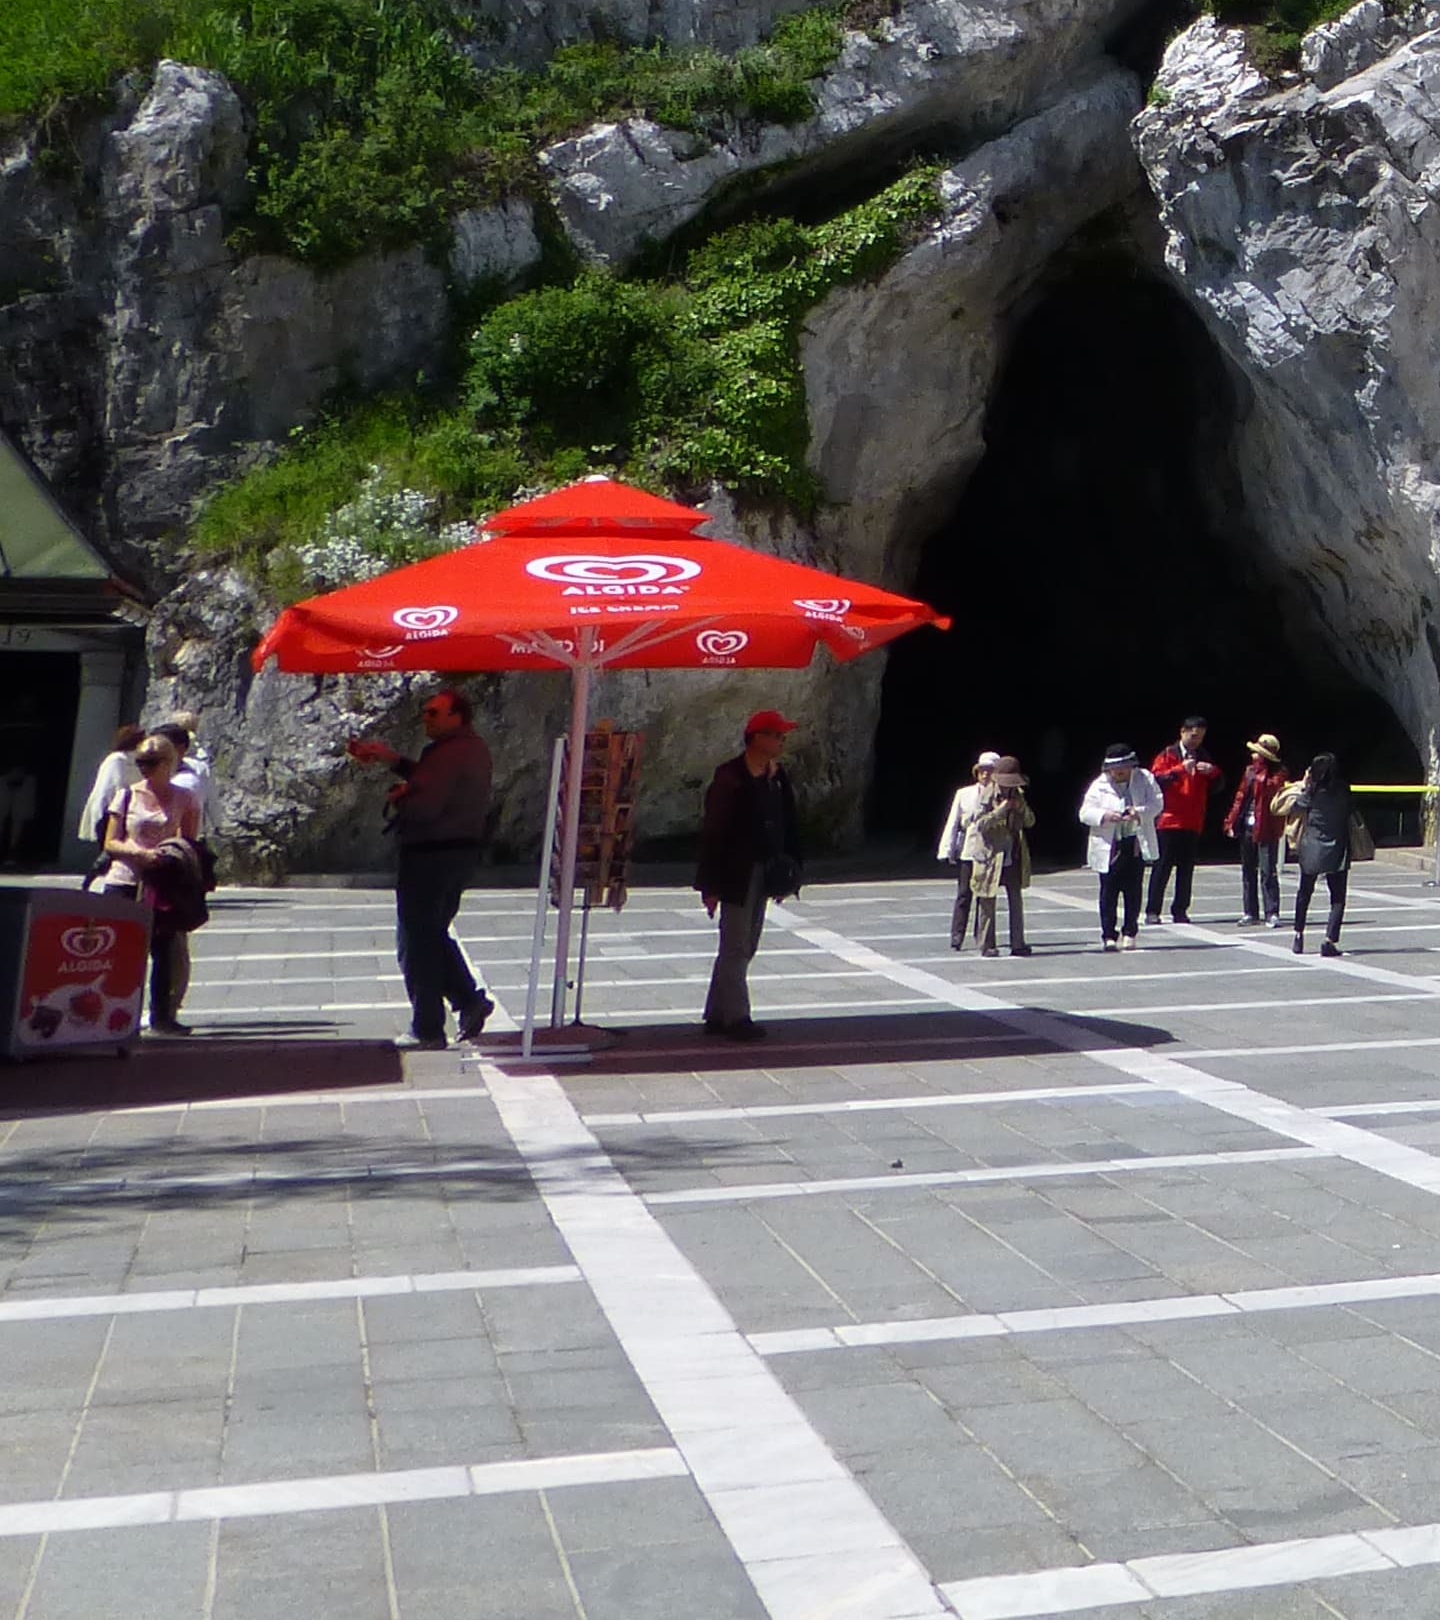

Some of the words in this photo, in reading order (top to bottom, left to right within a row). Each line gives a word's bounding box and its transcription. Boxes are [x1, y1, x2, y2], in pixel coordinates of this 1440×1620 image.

[562, 585, 684, 596] ALGIDA
[805, 611, 843, 622] ALGIDA
[405, 630, 449, 640] ALGIDA
[57, 960, 112, 973] ALGIDA
